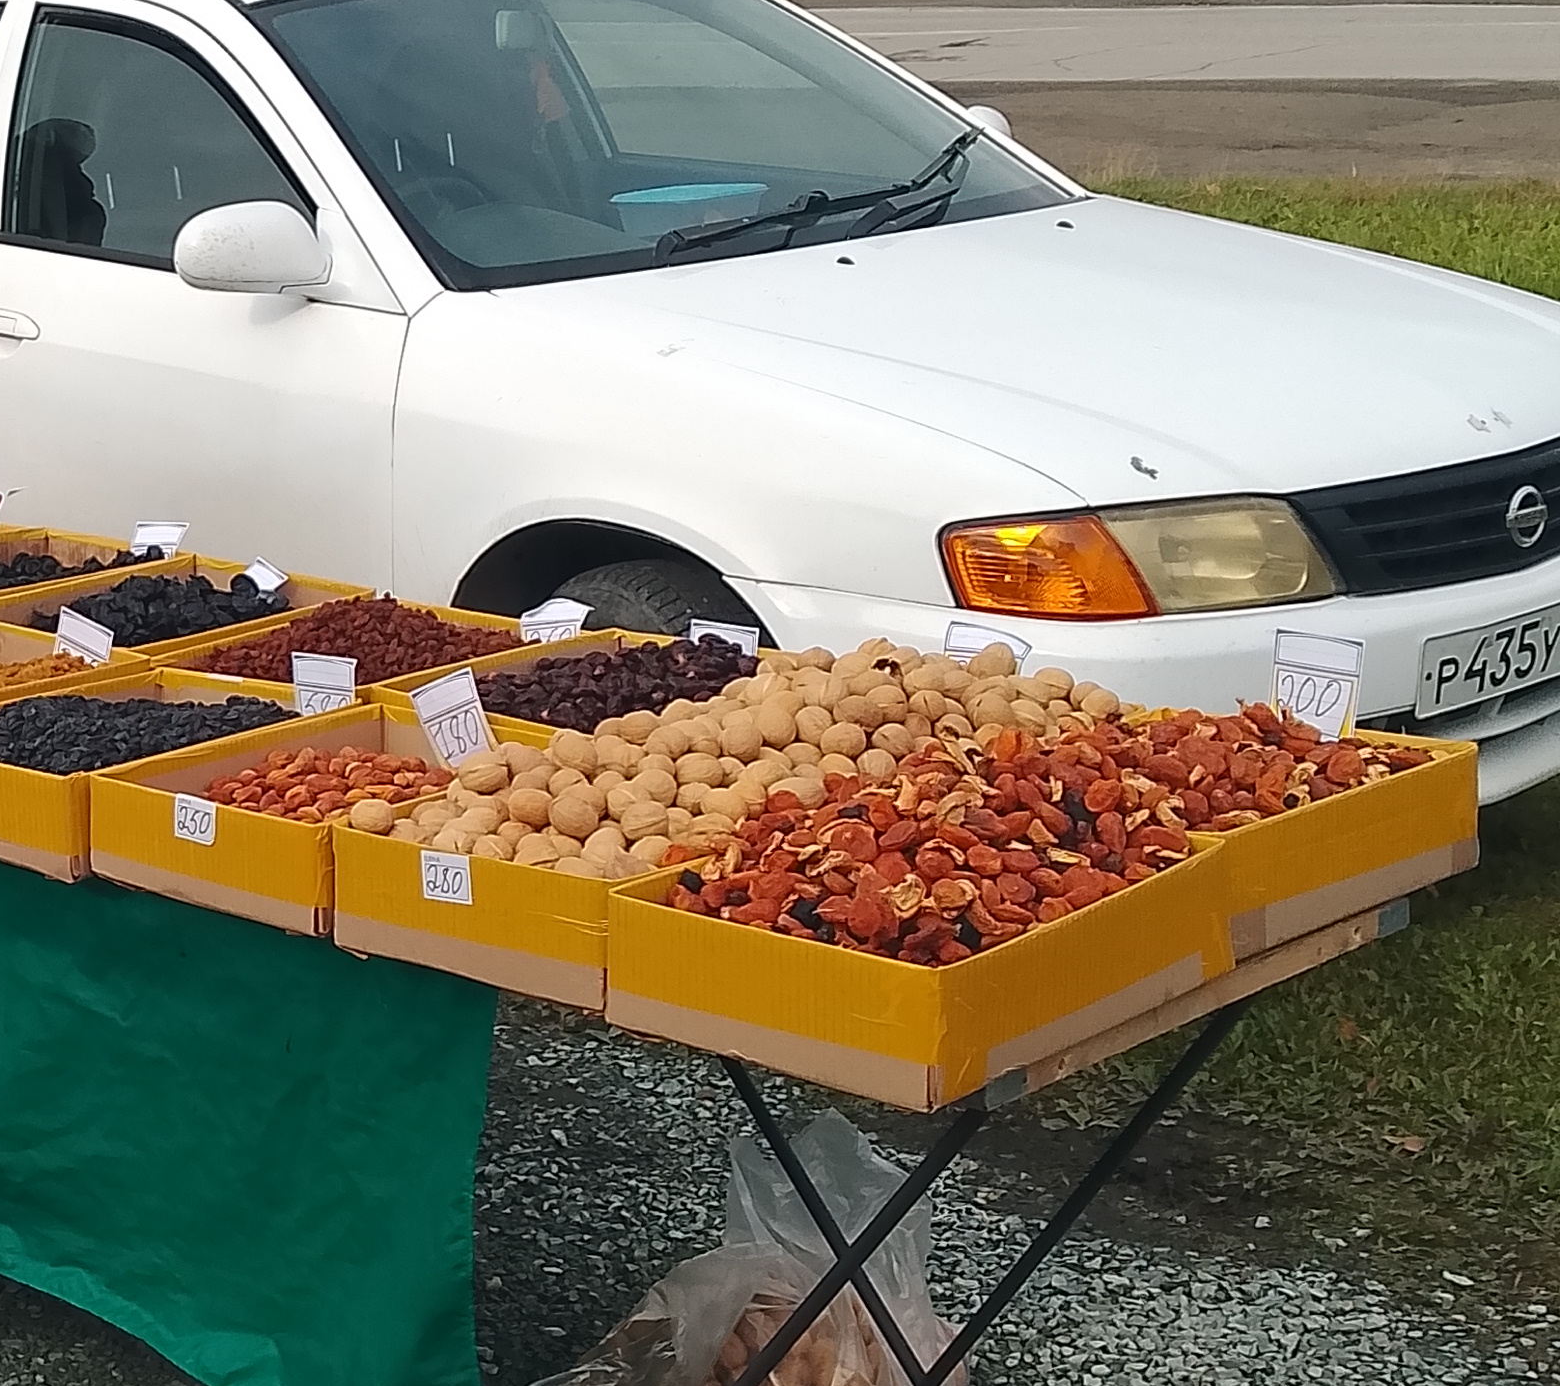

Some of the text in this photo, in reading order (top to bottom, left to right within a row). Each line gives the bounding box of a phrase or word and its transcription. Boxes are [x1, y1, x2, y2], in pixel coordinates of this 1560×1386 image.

[1278, 674, 1342, 717] 200
[434, 709, 478, 760] 180
[178, 806, 211, 835] 250
[426, 864, 463, 895] 280
